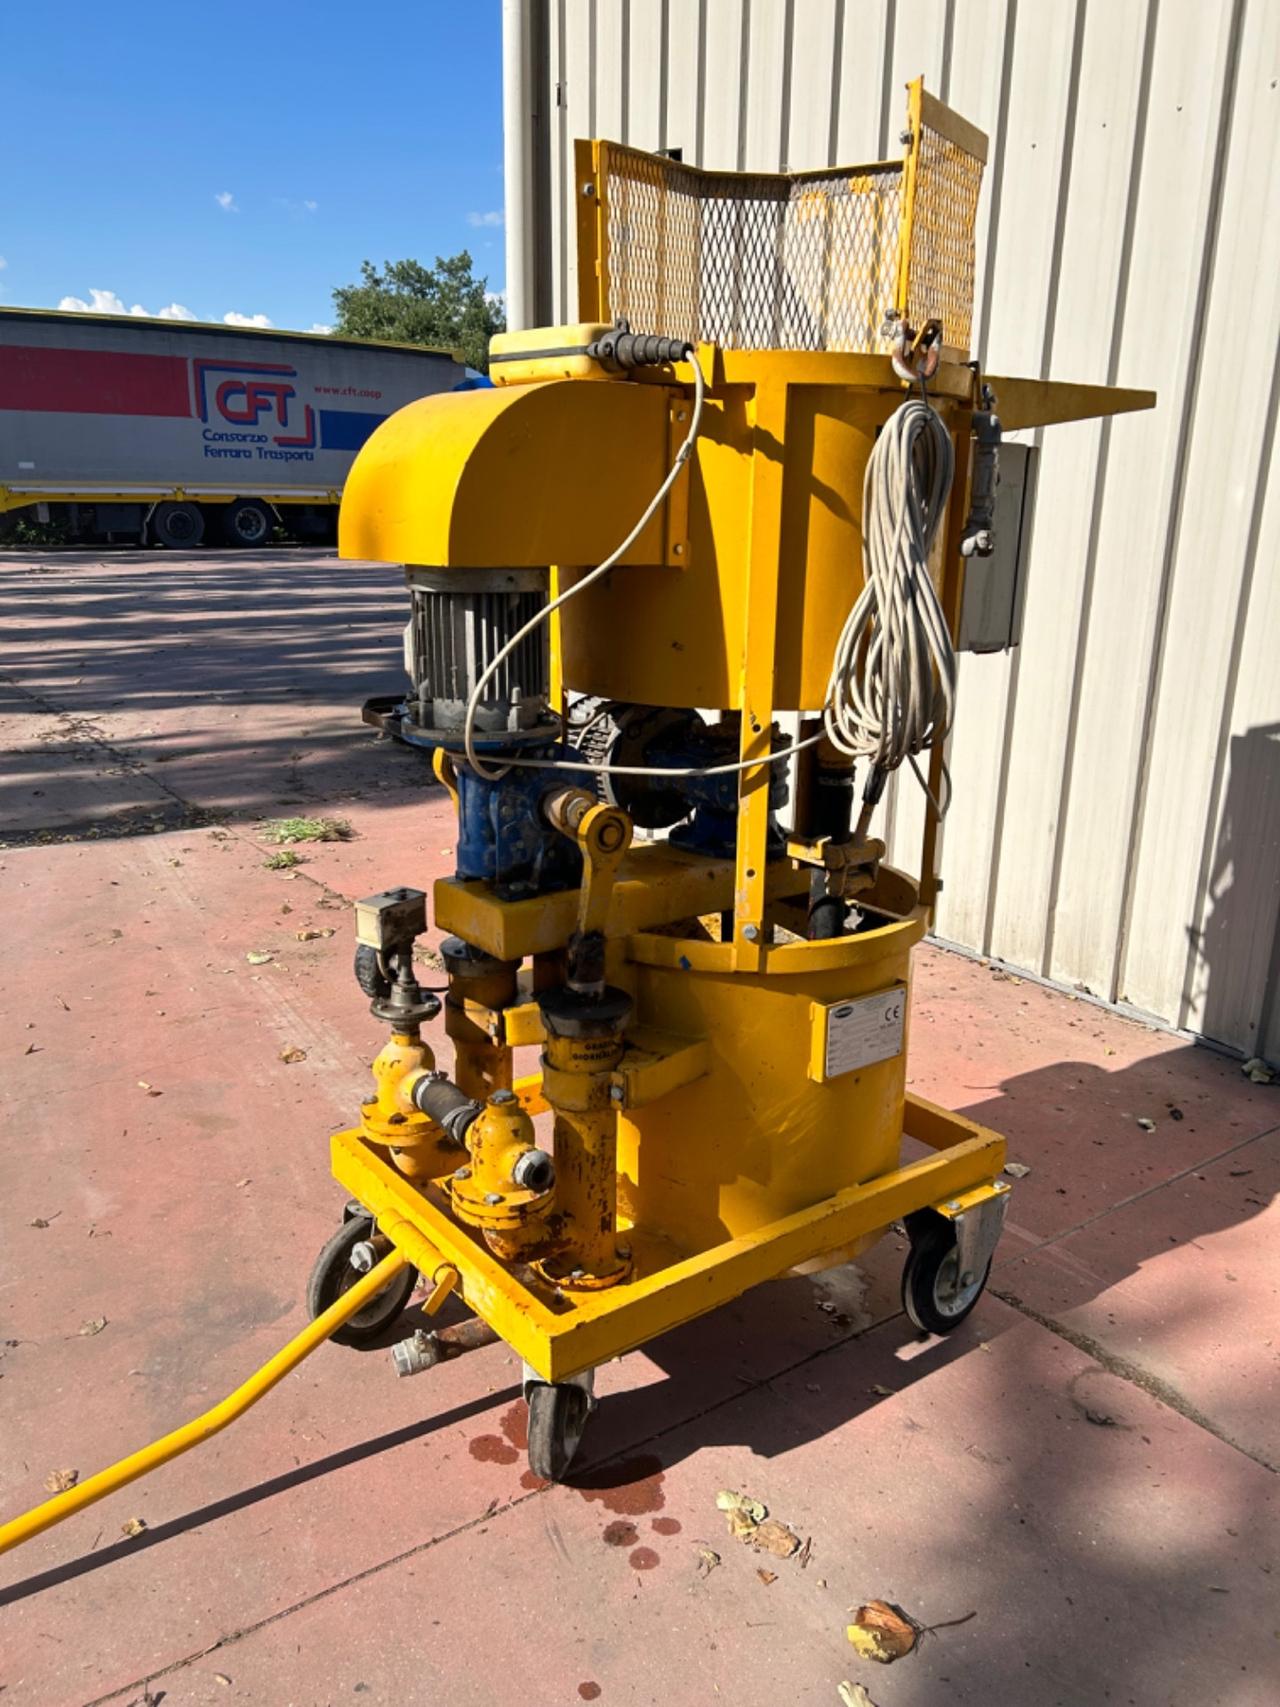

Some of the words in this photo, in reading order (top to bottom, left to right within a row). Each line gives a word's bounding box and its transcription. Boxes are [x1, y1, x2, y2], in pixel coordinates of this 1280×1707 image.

[314, 385, 382, 399] www.cft.coop
[215, 380, 295, 427] CFT
[202, 429, 268, 443] Consorzio
[204, 445, 252, 459] Ferrara
[256, 447, 315, 462] Trasporti
